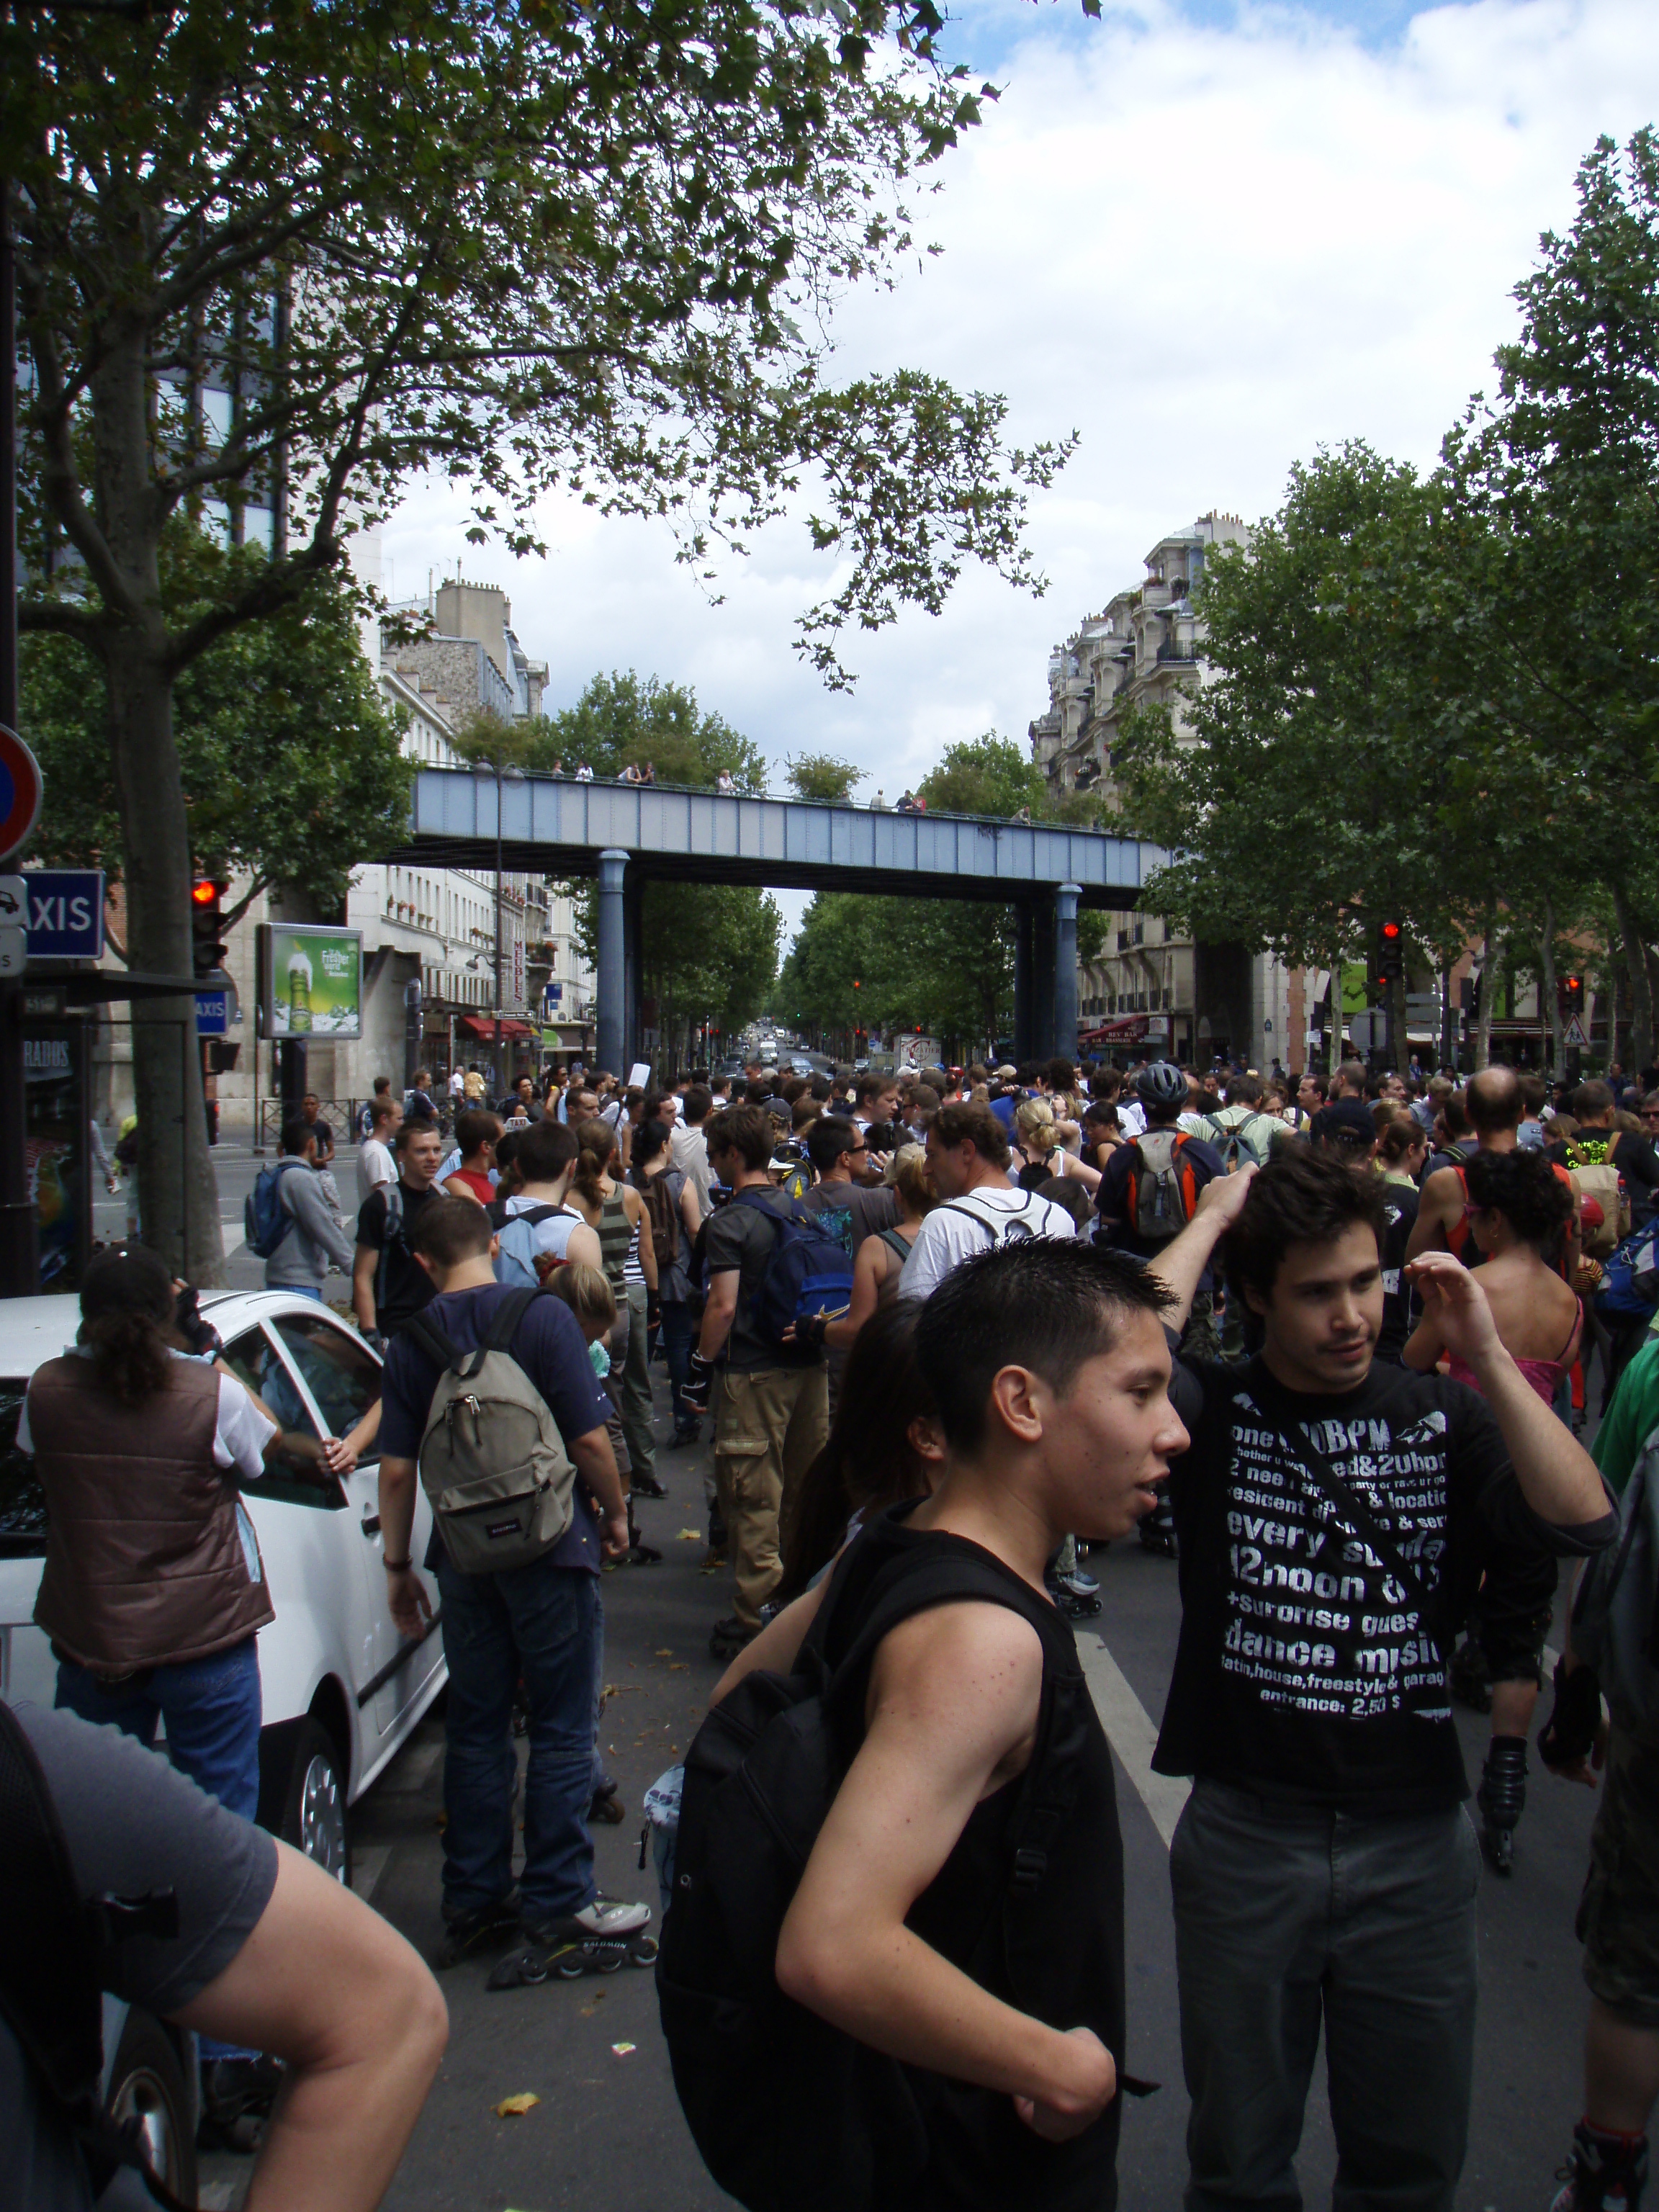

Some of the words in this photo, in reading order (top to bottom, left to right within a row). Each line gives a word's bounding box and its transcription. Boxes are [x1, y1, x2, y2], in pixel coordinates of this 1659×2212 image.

[514, 941, 523, 1002] MEUBLES
[1231, 1425, 1274, 1448] one
[1226, 1510, 1326, 1560] every
[1224, 1617, 1336, 1668] dance
[1260, 1688, 1346, 1714] entrance:
[1392, 1694, 1401, 1711] $
[583, 1941, 627, 1950] SALOMON
